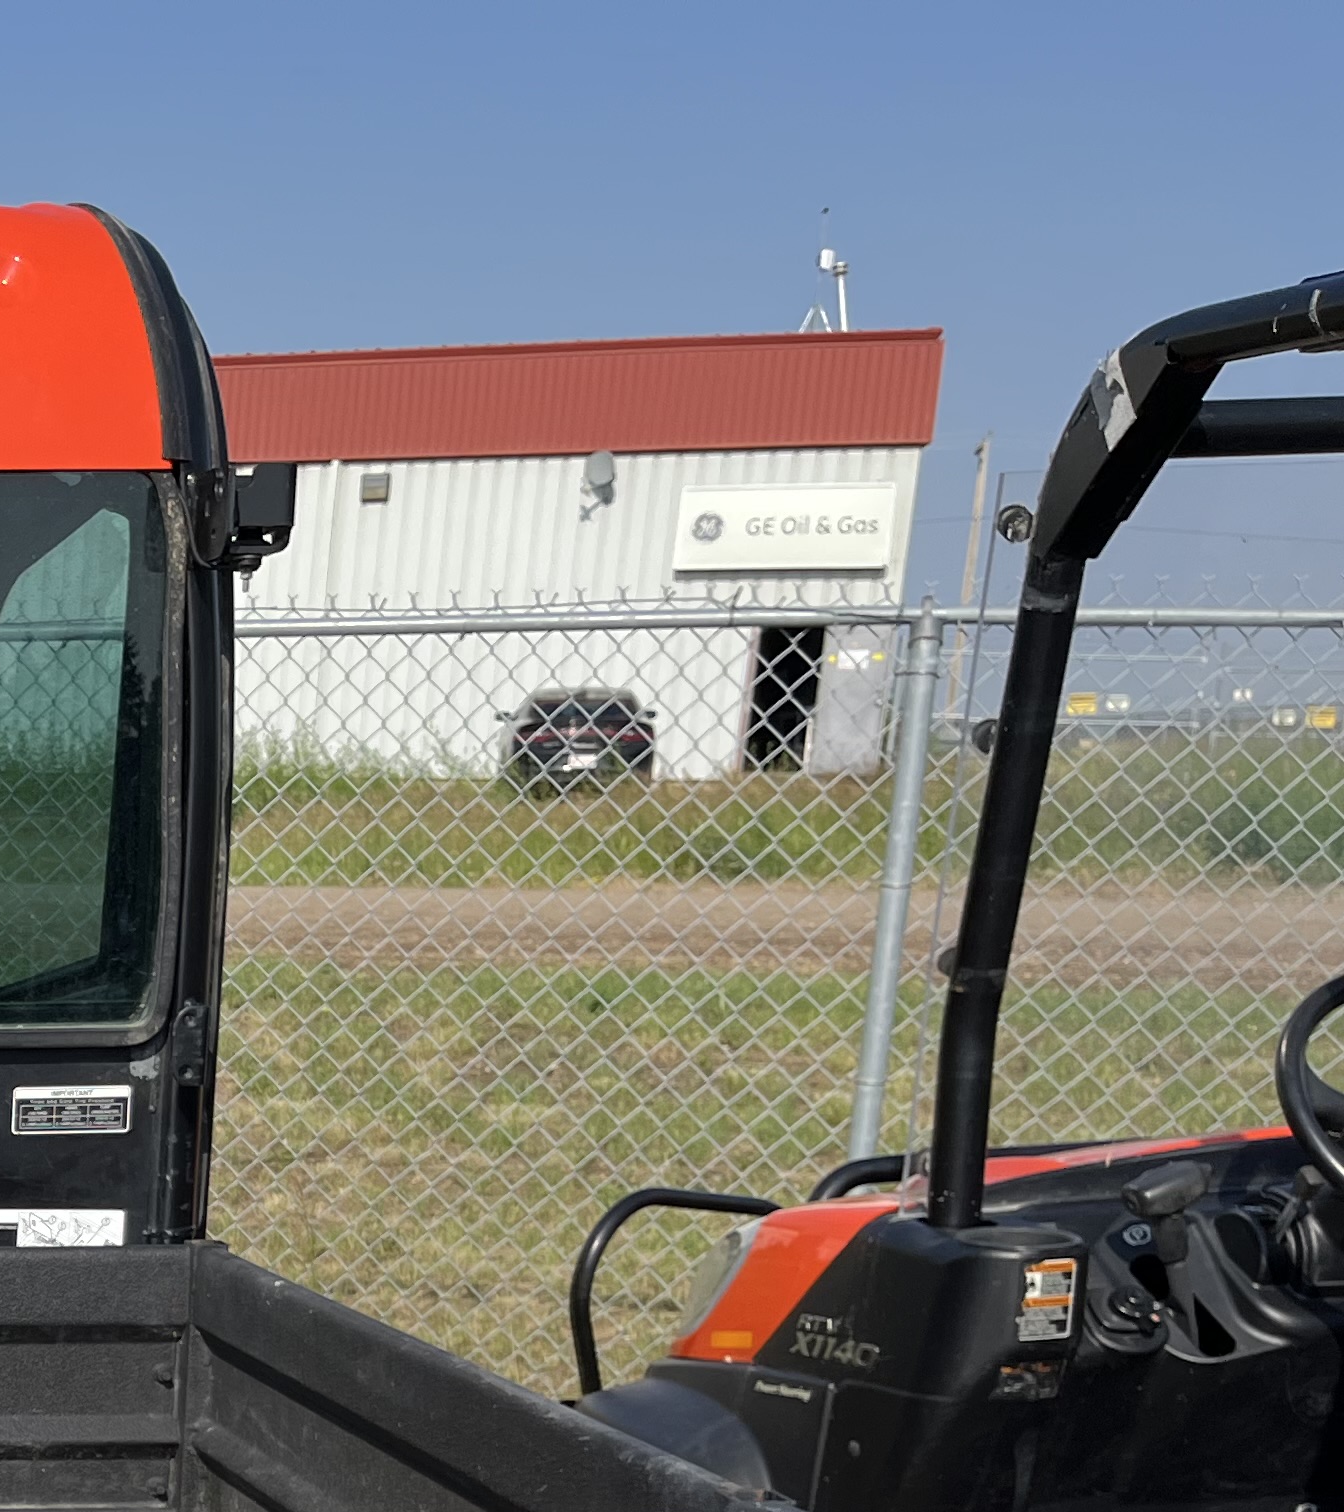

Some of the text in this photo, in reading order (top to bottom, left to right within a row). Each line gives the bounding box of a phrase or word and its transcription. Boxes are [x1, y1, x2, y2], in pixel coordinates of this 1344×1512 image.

[745, 516, 776, 536] GE
[780, 514, 811, 535] Oil
[815, 515, 832, 535] &
[837, 514, 879, 535] Gas
